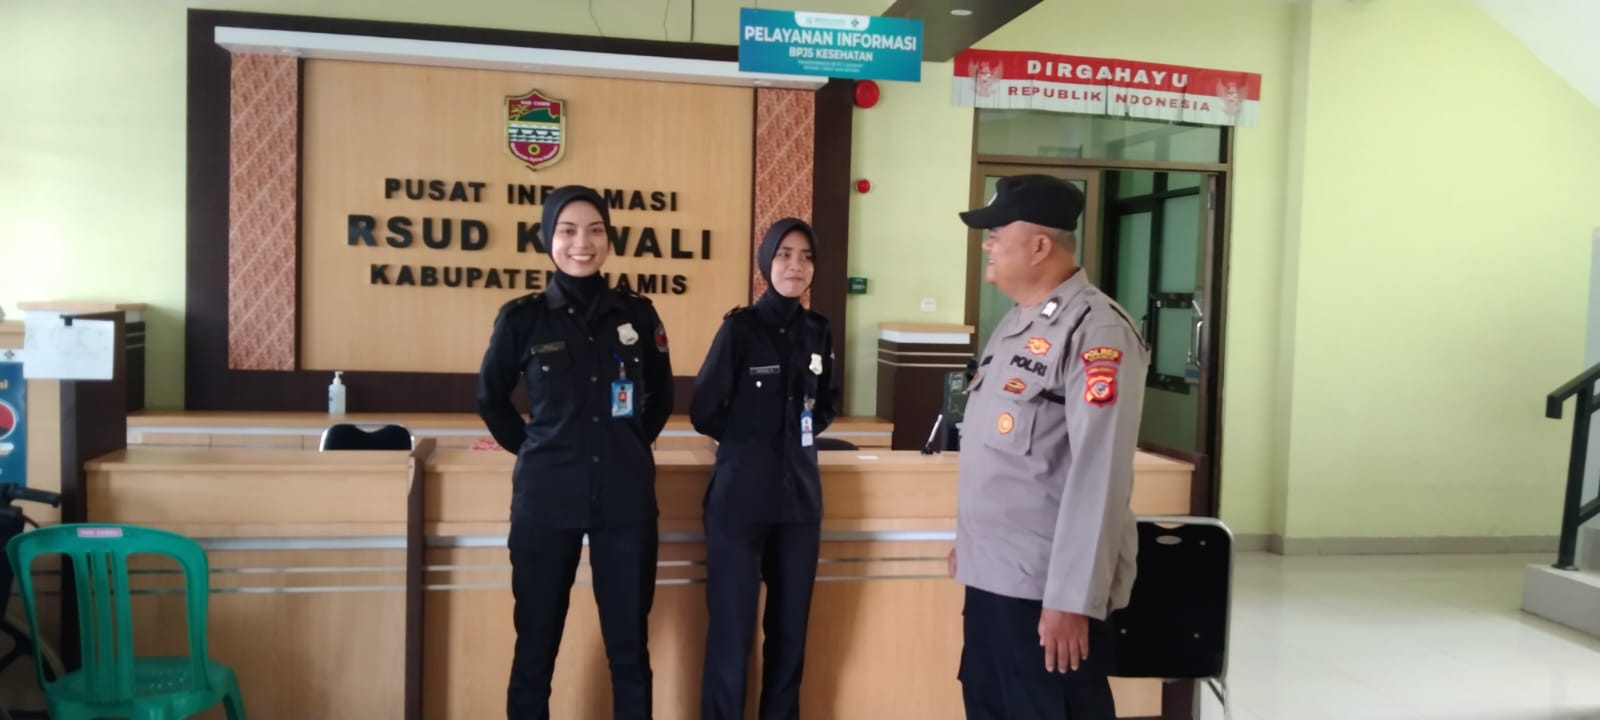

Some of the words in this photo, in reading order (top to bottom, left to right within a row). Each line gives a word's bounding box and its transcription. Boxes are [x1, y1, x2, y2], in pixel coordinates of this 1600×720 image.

[744, 25, 833, 46] PELAYANAN
[837, 31, 917, 51] INFORMASI
[789, 47, 813, 58] BPJS
[816, 48, 873, 62] KESEHATAN
[1027, 59, 1188, 88] DIRGAHAYU
[1008, 86, 1102, 102] REPUBLIK
[384, 178, 487, 203] PUSAT
[507, 183, 678, 212] INFMASI
[347, 214, 490, 251] RSUD
[517, 221, 711, 260] KWALI
[1010, 354, 1048, 377] POLRI
